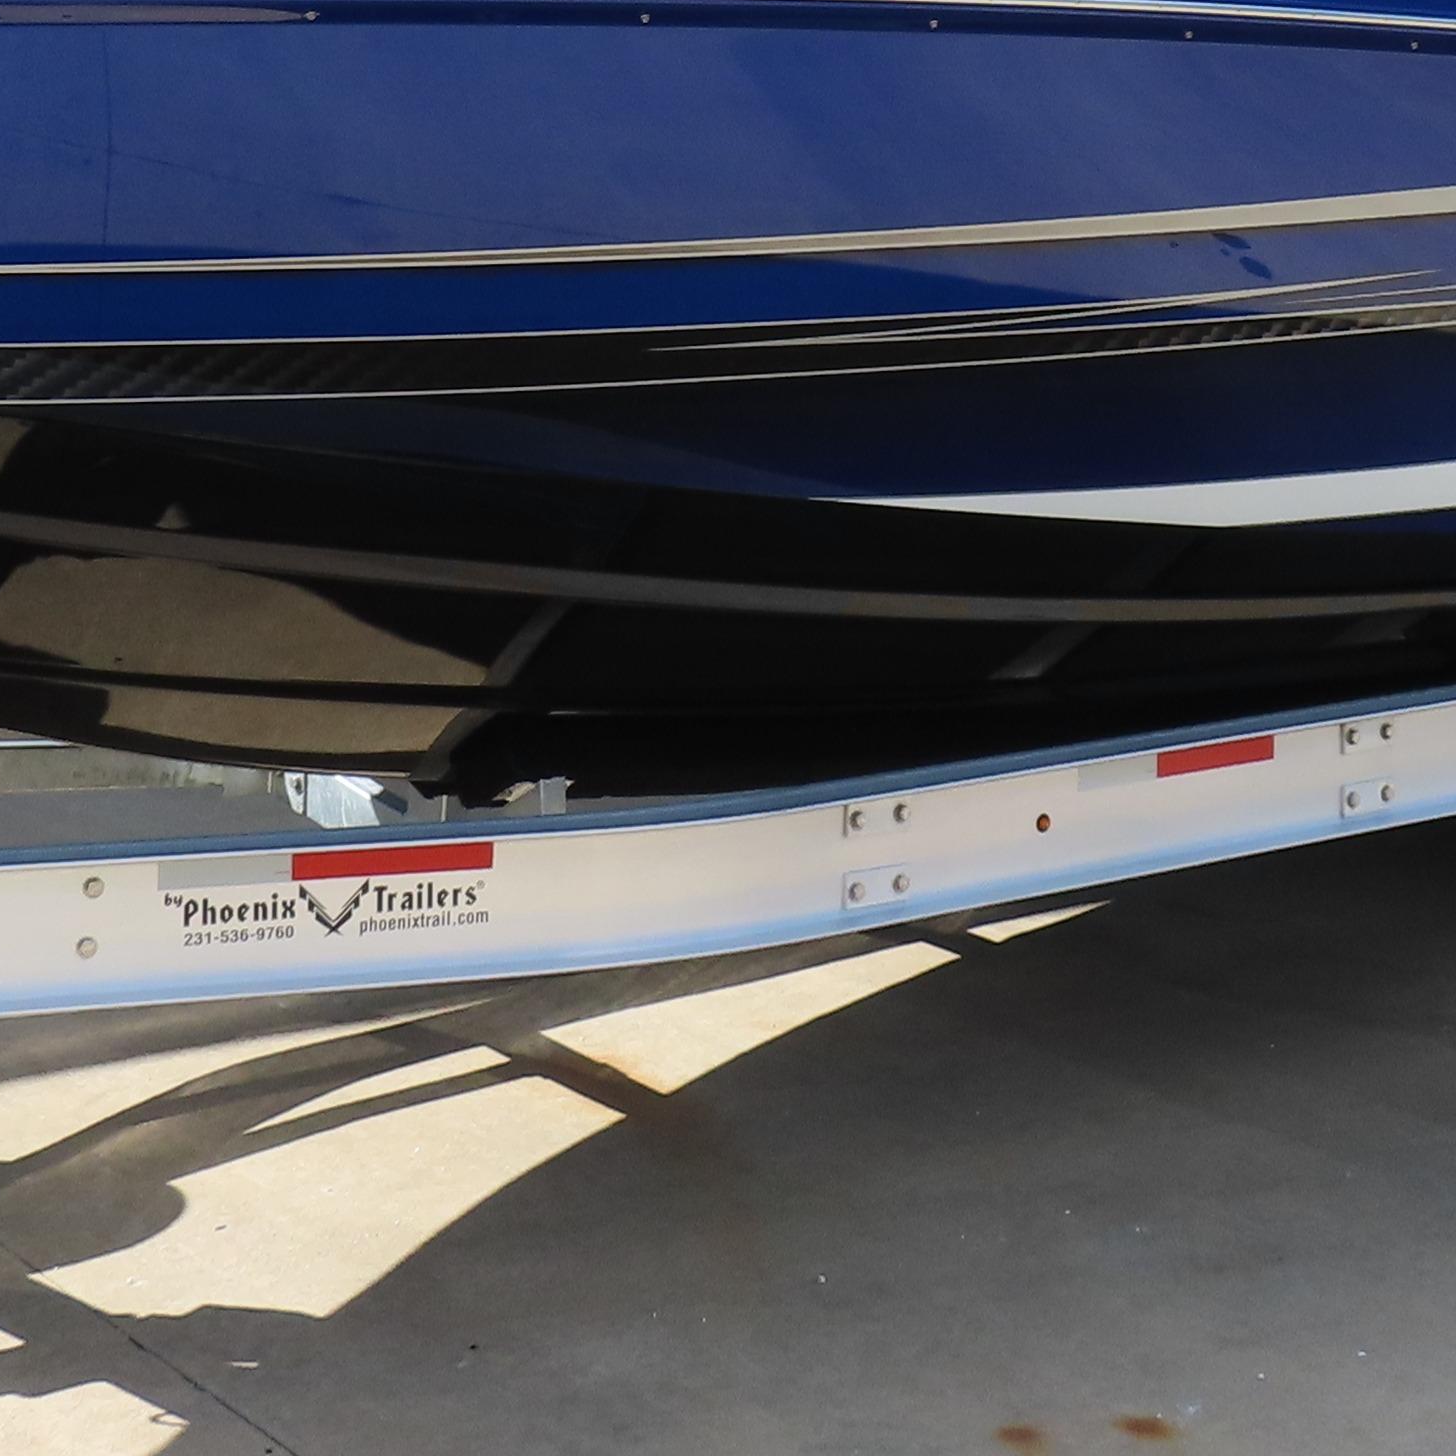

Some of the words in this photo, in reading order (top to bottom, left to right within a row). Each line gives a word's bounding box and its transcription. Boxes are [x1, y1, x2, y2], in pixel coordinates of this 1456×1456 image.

[164, 893, 183, 908] by
[184, 892, 296, 927] Phoenix
[184, 925, 294, 946] 231-536-9760
[359, 910, 489, 936] phoenixtrail.com
